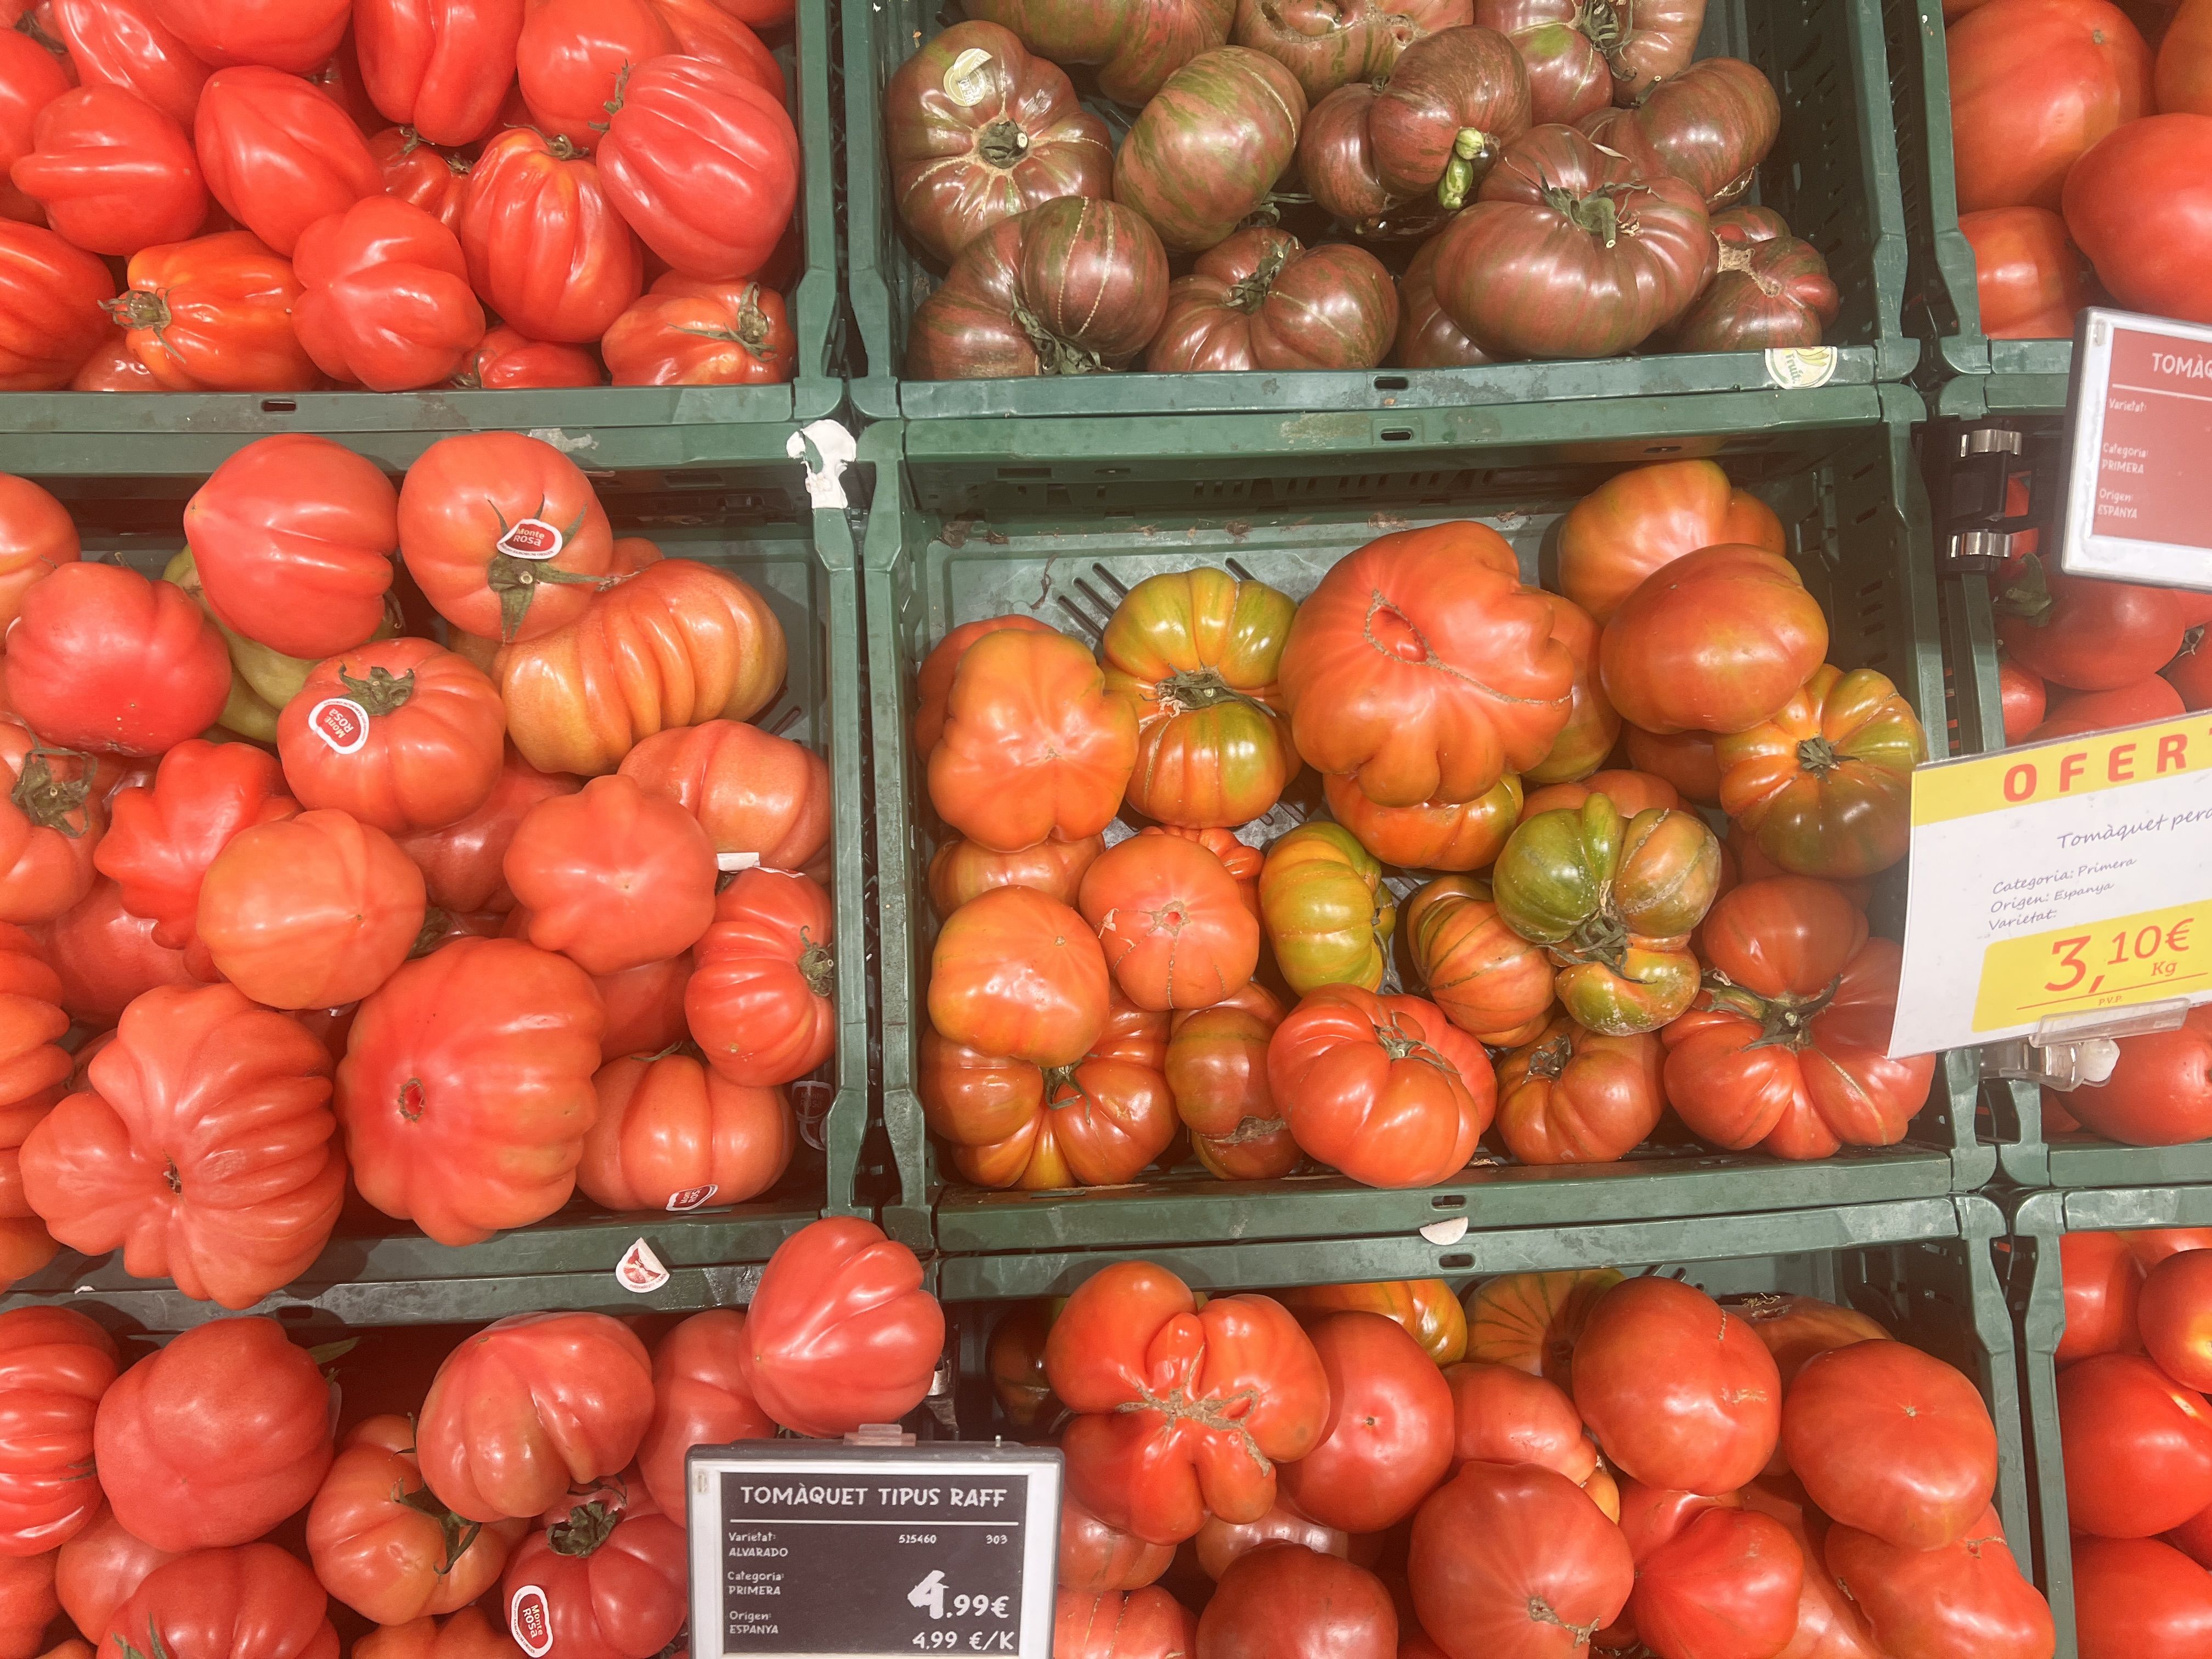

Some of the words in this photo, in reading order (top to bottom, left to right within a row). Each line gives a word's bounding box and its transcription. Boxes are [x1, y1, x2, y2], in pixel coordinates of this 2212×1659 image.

[2108, 398, 2147, 413] Varietat:
[2103, 442, 2149, 459] Categoria:
[2102, 459, 2145, 474] PRIMERA
[2099, 487, 2134, 504] Origen:
[2097, 504, 2138, 519] ESPANYA
[516, 528, 545, 540] Monte
[2004, 727, 2212, 803] OFER
[2057, 814, 2168, 850] Tomàquet
[1993, 870, 2075, 895] Categoria:
[2078, 857, 2137, 878] Primera
[1990, 892, 2050, 913] Origen:
[2053, 883, 2116, 902] Espanya
[1989, 910, 2057, 930] Varietat:
[2151, 961, 2177, 977] Kg
[741, 1483, 868, 1506] TOMÀQUET
[879, 1487, 940, 1507] TIPUS
[950, 1488, 1007, 1508] RAFF
[728, 1532, 776, 1542] Varietat:
[899, 1534, 937, 1544] 515460
[985, 1534, 1008, 1545] 303
[729, 1547, 789, 1557] ALVARADO
[727, 1571, 784, 1584] Categoria:
[728, 1585, 781, 1596] PRIMERA
[907, 1570, 1010, 1620] 4.99€
[531, 1604, 543, 1635] Monte
[730, 1611, 772, 1622] Origen:
[730, 1624, 778, 1635] ESPANYA
[968, 1630, 1015, 1651] €/K
